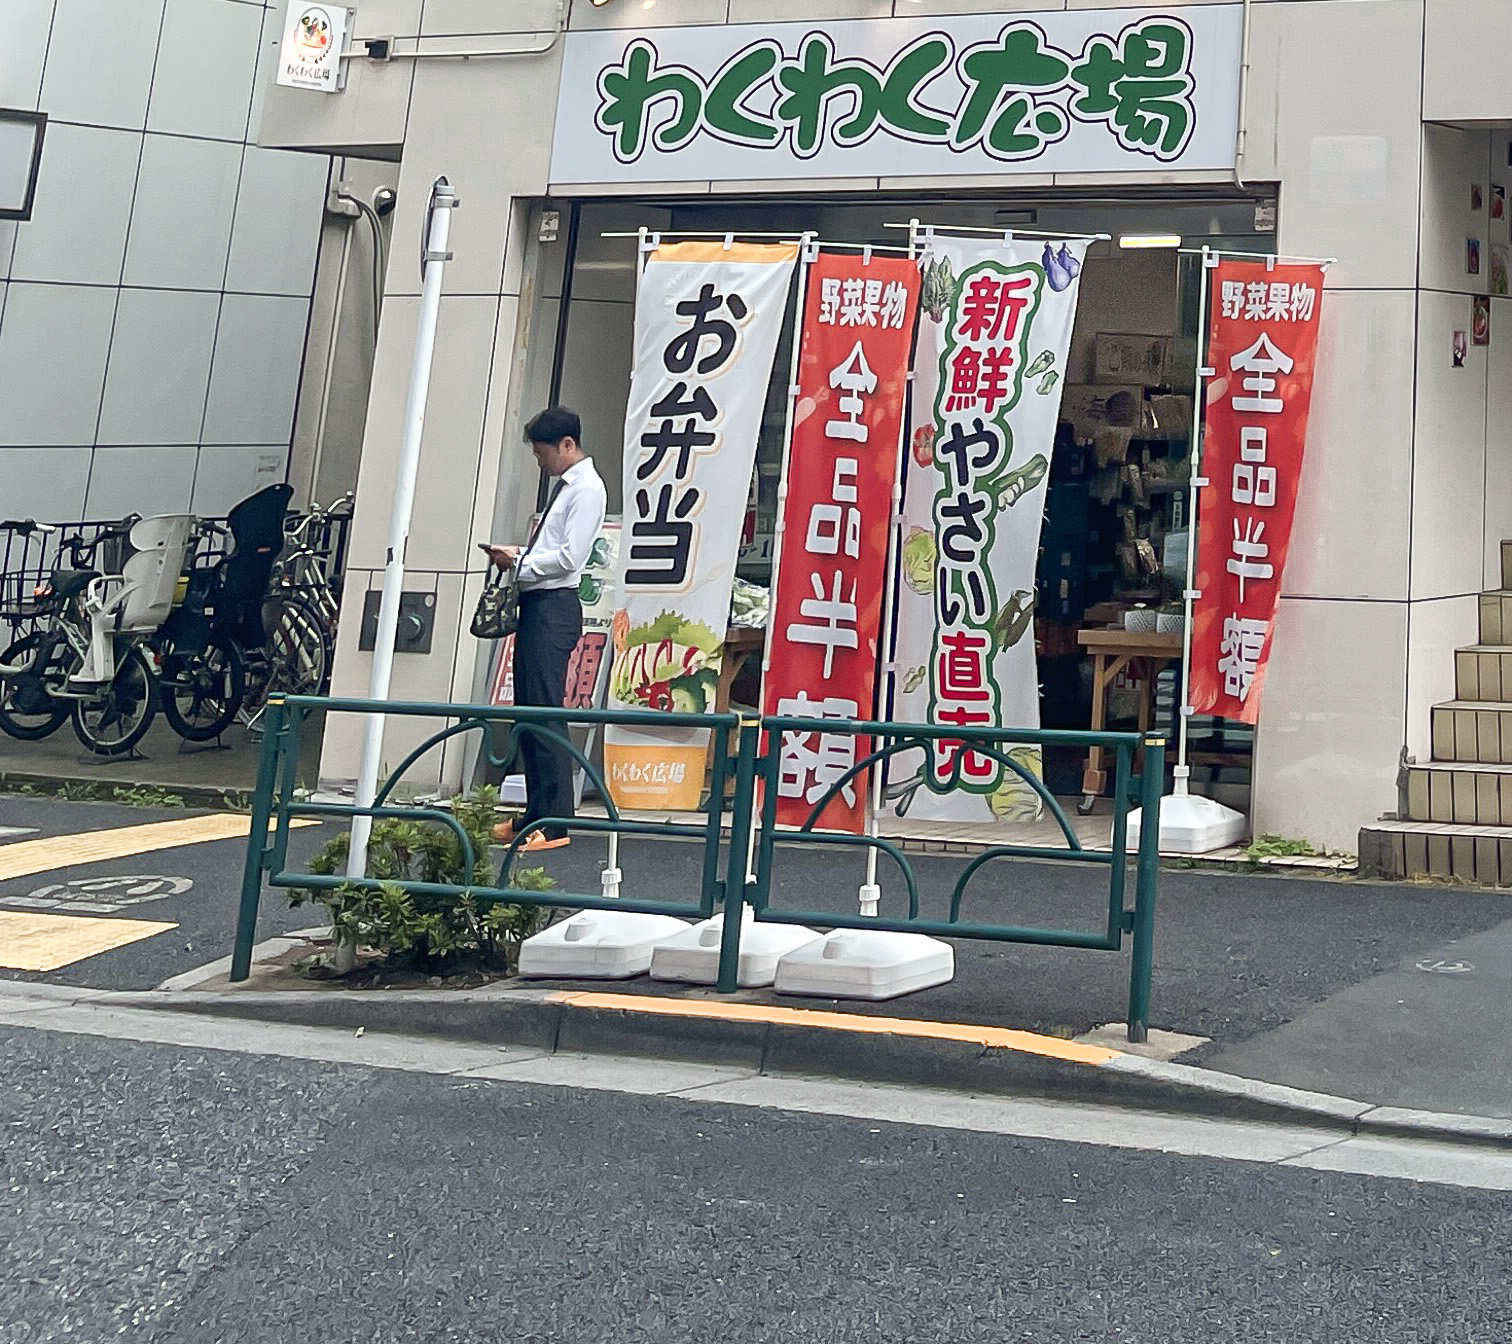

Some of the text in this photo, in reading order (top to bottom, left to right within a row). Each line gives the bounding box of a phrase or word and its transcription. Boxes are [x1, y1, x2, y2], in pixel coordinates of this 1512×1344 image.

[596, 16, 1197, 162] わくわく広場
[624, 283, 748, 585] お弁当
[818, 277, 908, 330] 野菜果物
[1220, 280, 1317, 323] 野菜果物
[777, 339, 878, 809] 全品半額
[937, 275, 1032, 777] 新鮮やさい直売
[1218, 331, 1294, 702] 全品半額
